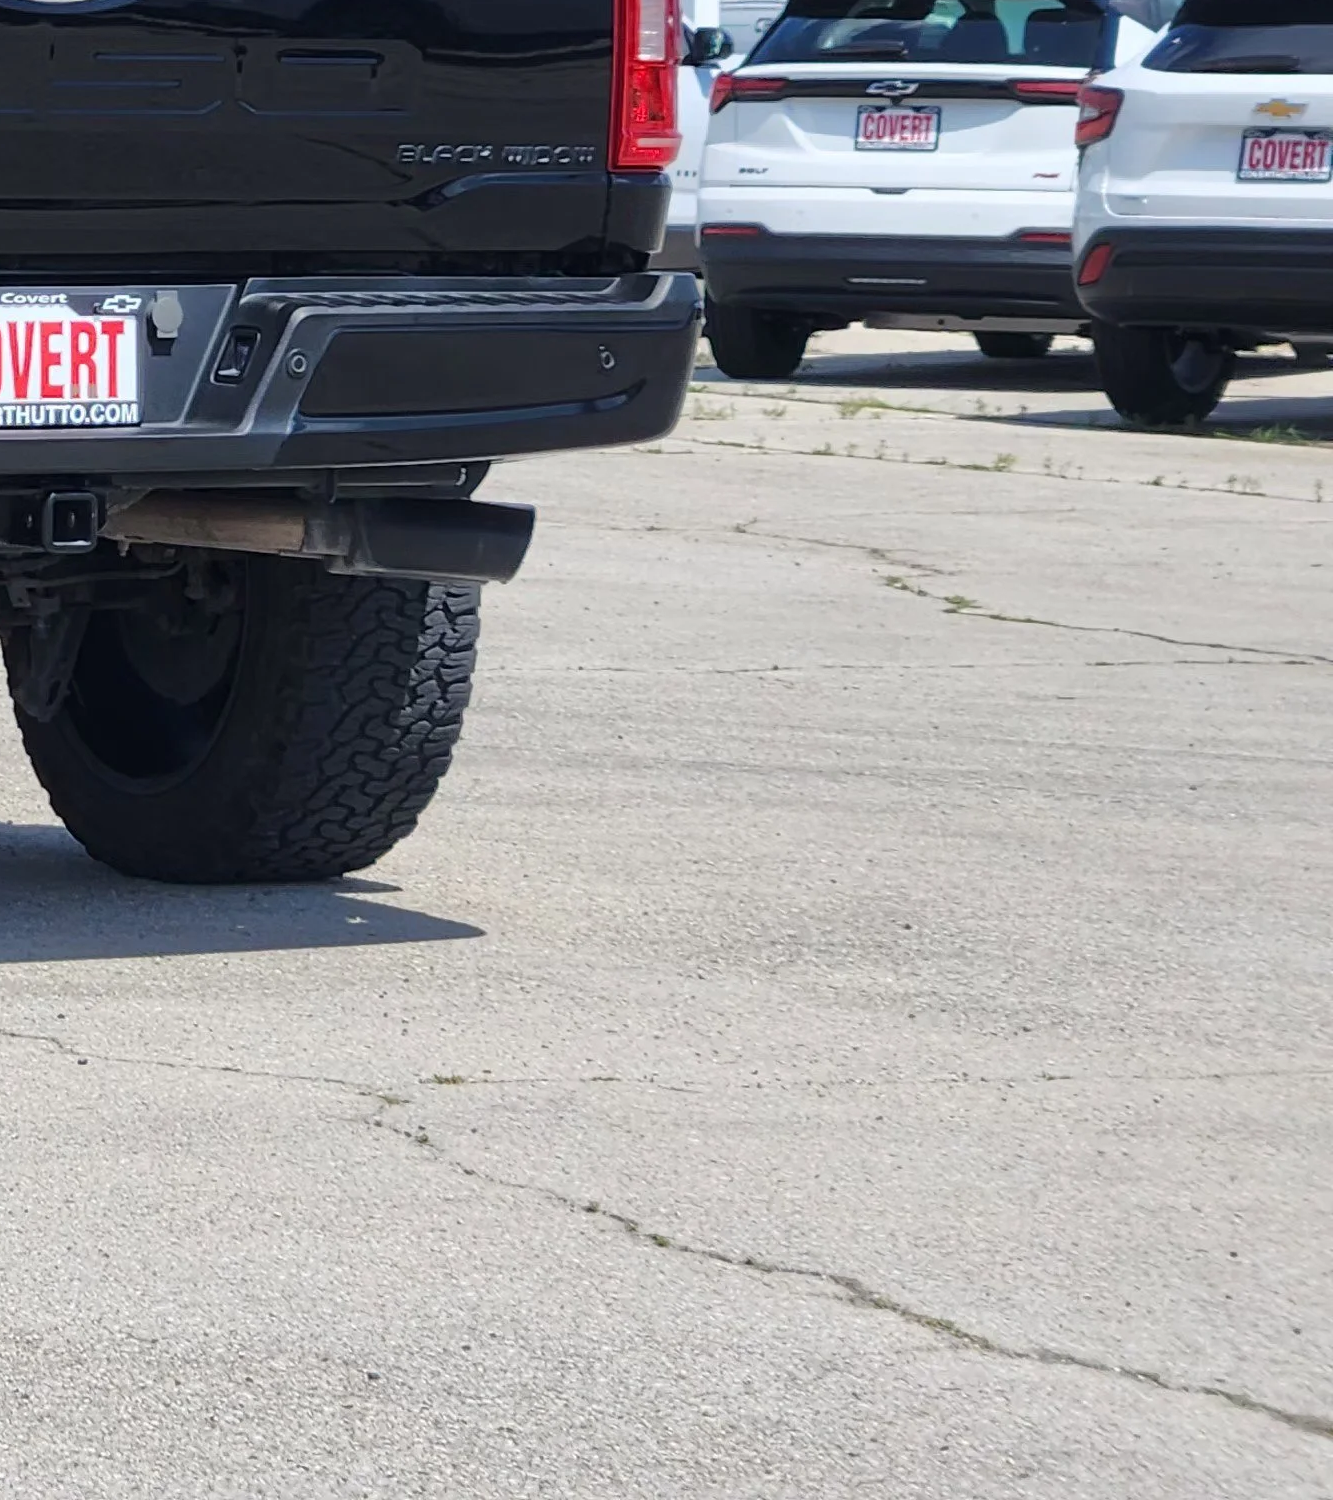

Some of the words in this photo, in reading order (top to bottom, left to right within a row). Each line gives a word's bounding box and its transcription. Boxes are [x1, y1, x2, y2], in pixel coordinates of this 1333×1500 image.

[863, 112, 933, 140] COVERT
[397, 144, 493, 164] BLACK
[1248, 139, 1329, 171] COVERT
[0, 291, 68, 304] Covert
